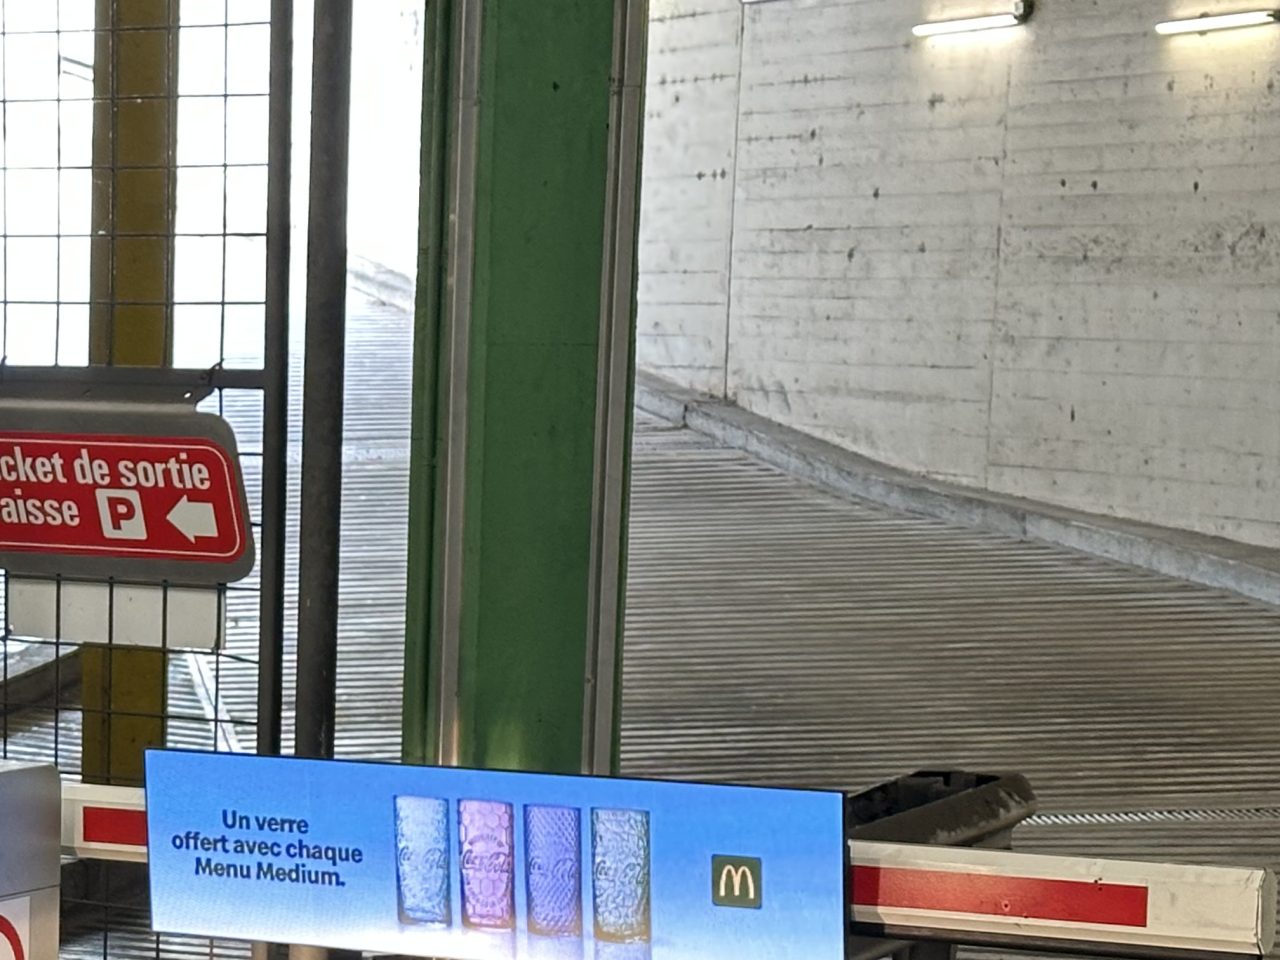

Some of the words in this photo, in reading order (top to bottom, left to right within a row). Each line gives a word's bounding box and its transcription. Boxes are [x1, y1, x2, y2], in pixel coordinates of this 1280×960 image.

[73, 448, 111, 486] de
[119, 453, 211, 490] sortie
[106, 496, 137, 531] P
[222, 809, 251, 830] Un
[255, 815, 309, 834] verre
[171, 831, 230, 854] offert
[233, 838, 282, 857] avec
[285, 839, 364, 867] chaque
[195, 856, 251, 879] Menu
[256, 861, 346, 887] Medium.
